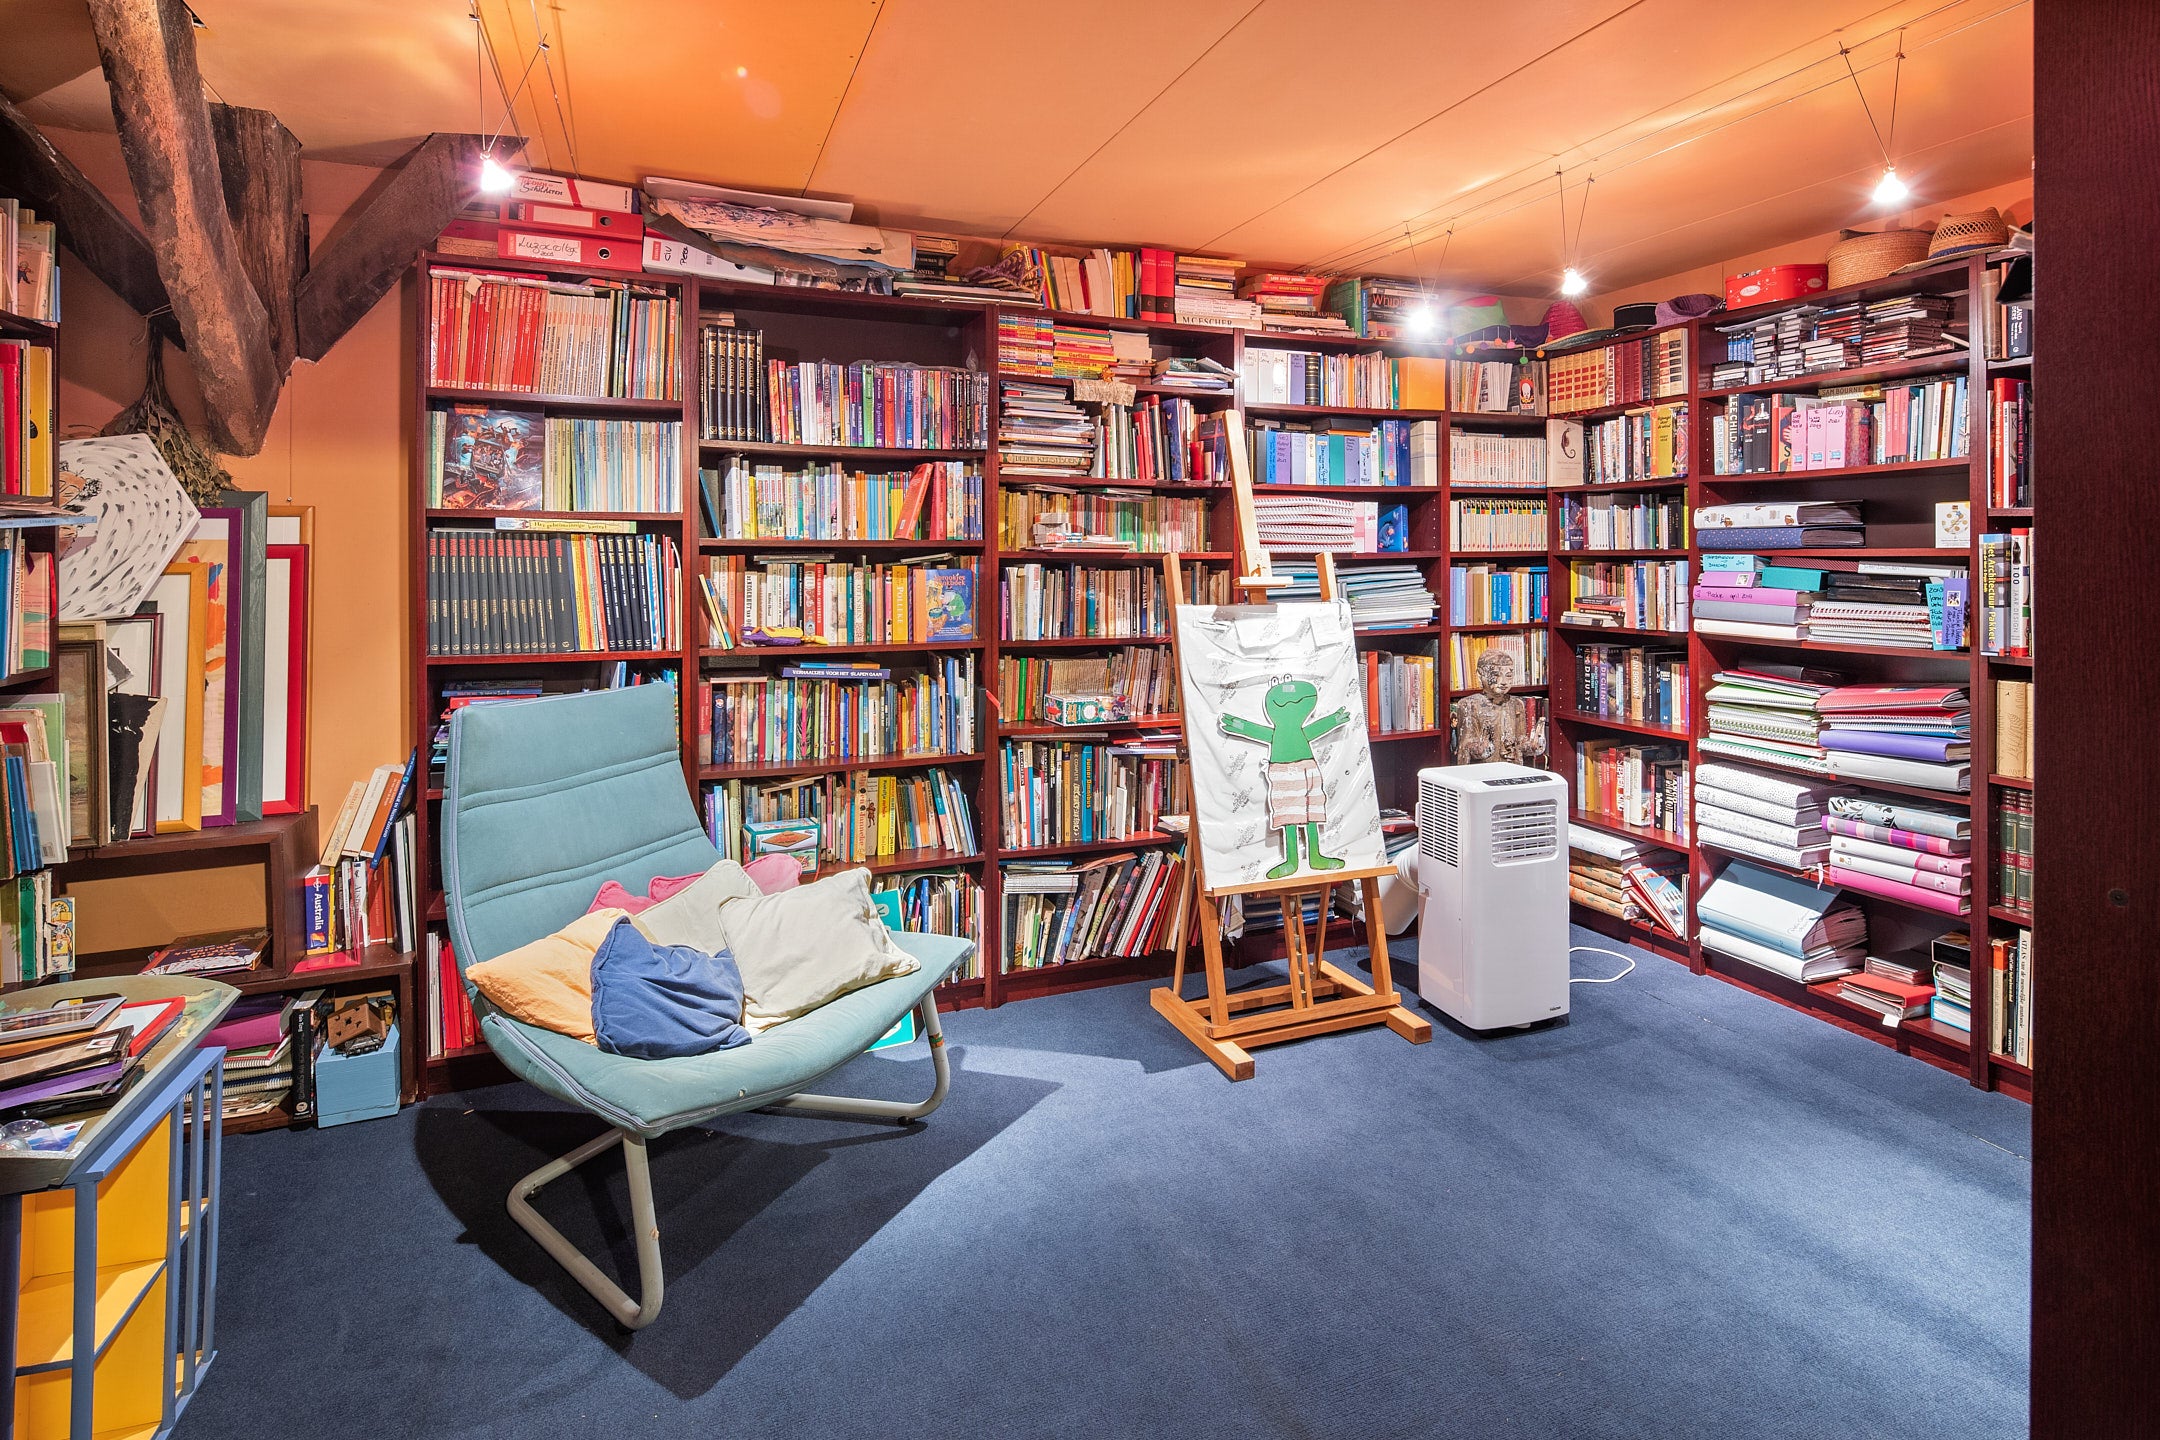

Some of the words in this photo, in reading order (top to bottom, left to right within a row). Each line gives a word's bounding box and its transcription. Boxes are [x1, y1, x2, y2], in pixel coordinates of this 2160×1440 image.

[1821, 388, 1836, 397] SAM
[1837, 386, 1861, 396] BOURNE
[1730, 396, 1738, 413] LEE
[1729, 414, 1738, 442] CHILD
[1988, 544, 1996, 557] Het
[1988, 559, 1996, 608] Architectuur
[2012, 566, 2020, 585] 100
[896, 586, 904, 623] POLLEKE
[1988, 611, 1996, 640] Pakket
[1584, 666, 1591, 678] DE
[1616, 760, 1624, 788] STEPHEN
[1616, 794, 1624, 811] KING
[313, 893, 323, 930] Australia
